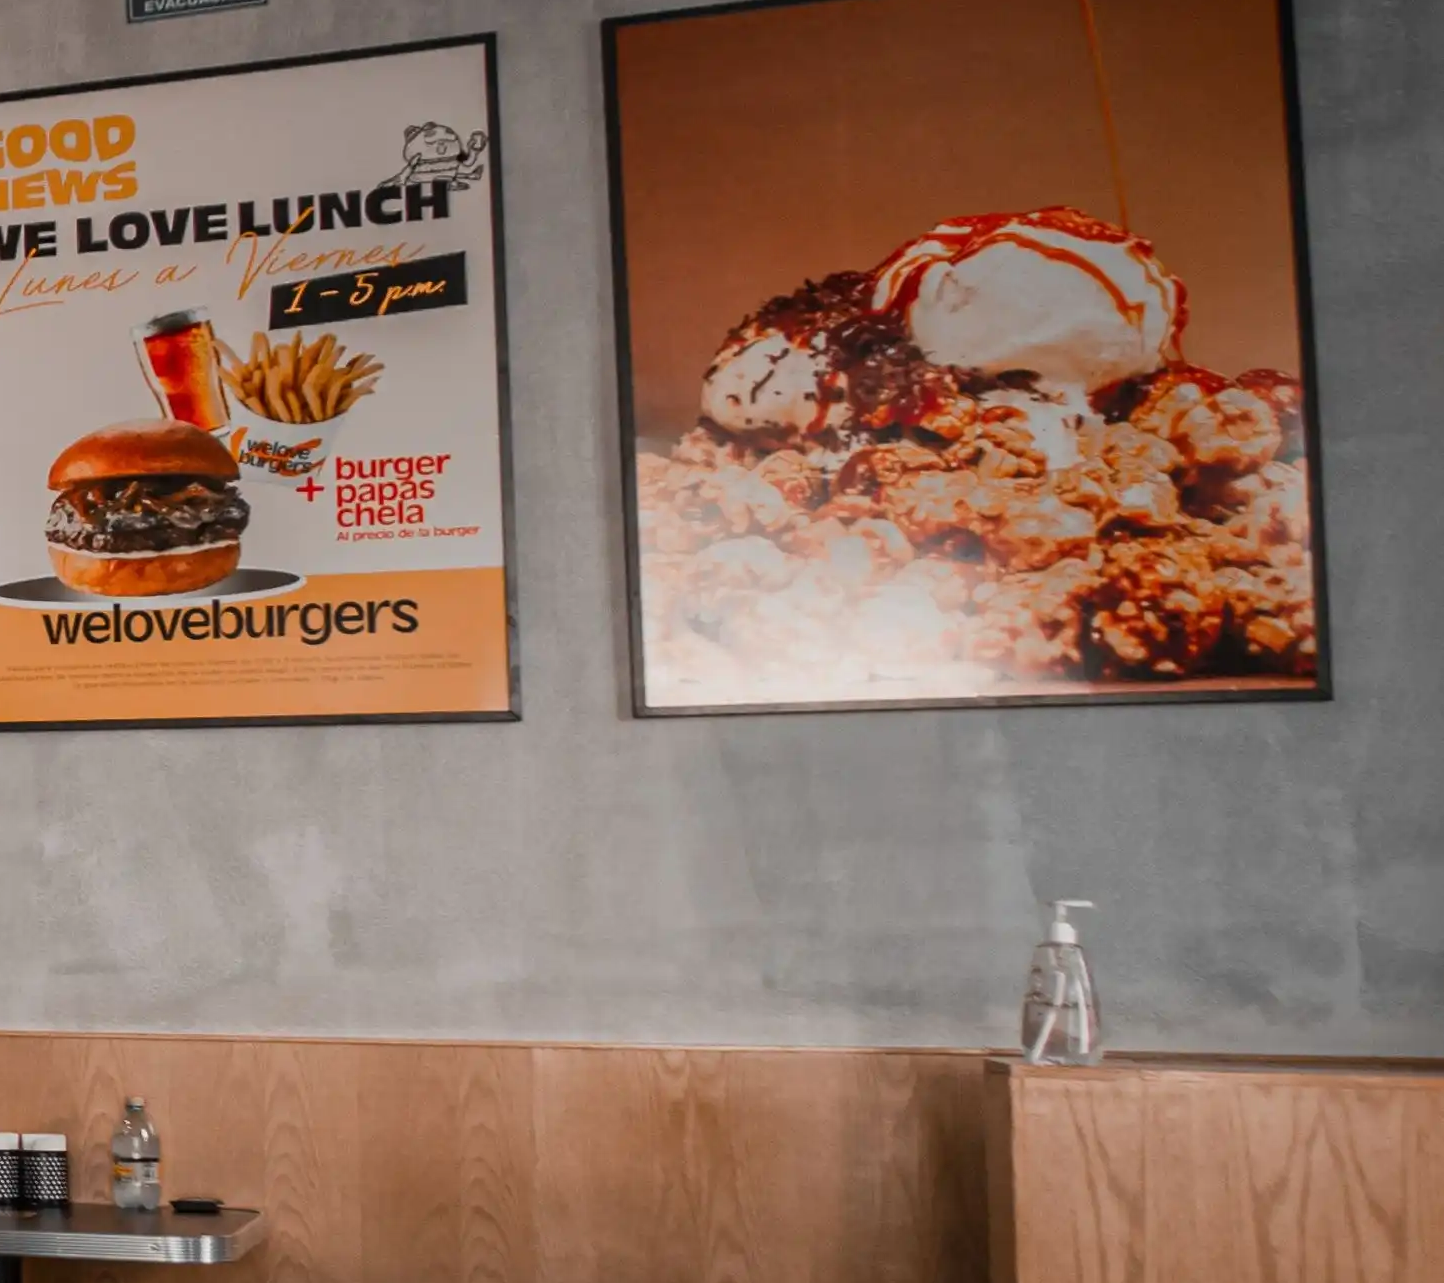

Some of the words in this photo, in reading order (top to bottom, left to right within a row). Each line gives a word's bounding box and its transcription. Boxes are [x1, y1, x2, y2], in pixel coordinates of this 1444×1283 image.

[77, 203, 228, 254] LOVE
[238, 179, 449, 238] LUNCH
[154, 264, 198, 285] a
[226, 206, 425, 301] Viernes
[284, 279, 310, 314] 1
[349, 272, 379, 305] 5
[335, 454, 451, 481] burger
[336, 479, 436, 507] papas
[336, 500, 424, 527] chela
[353, 530, 395, 543] precio
[398, 527, 415, 539] de
[433, 525, 481, 539] burger
[41, 598, 420, 646] weloveburgers
